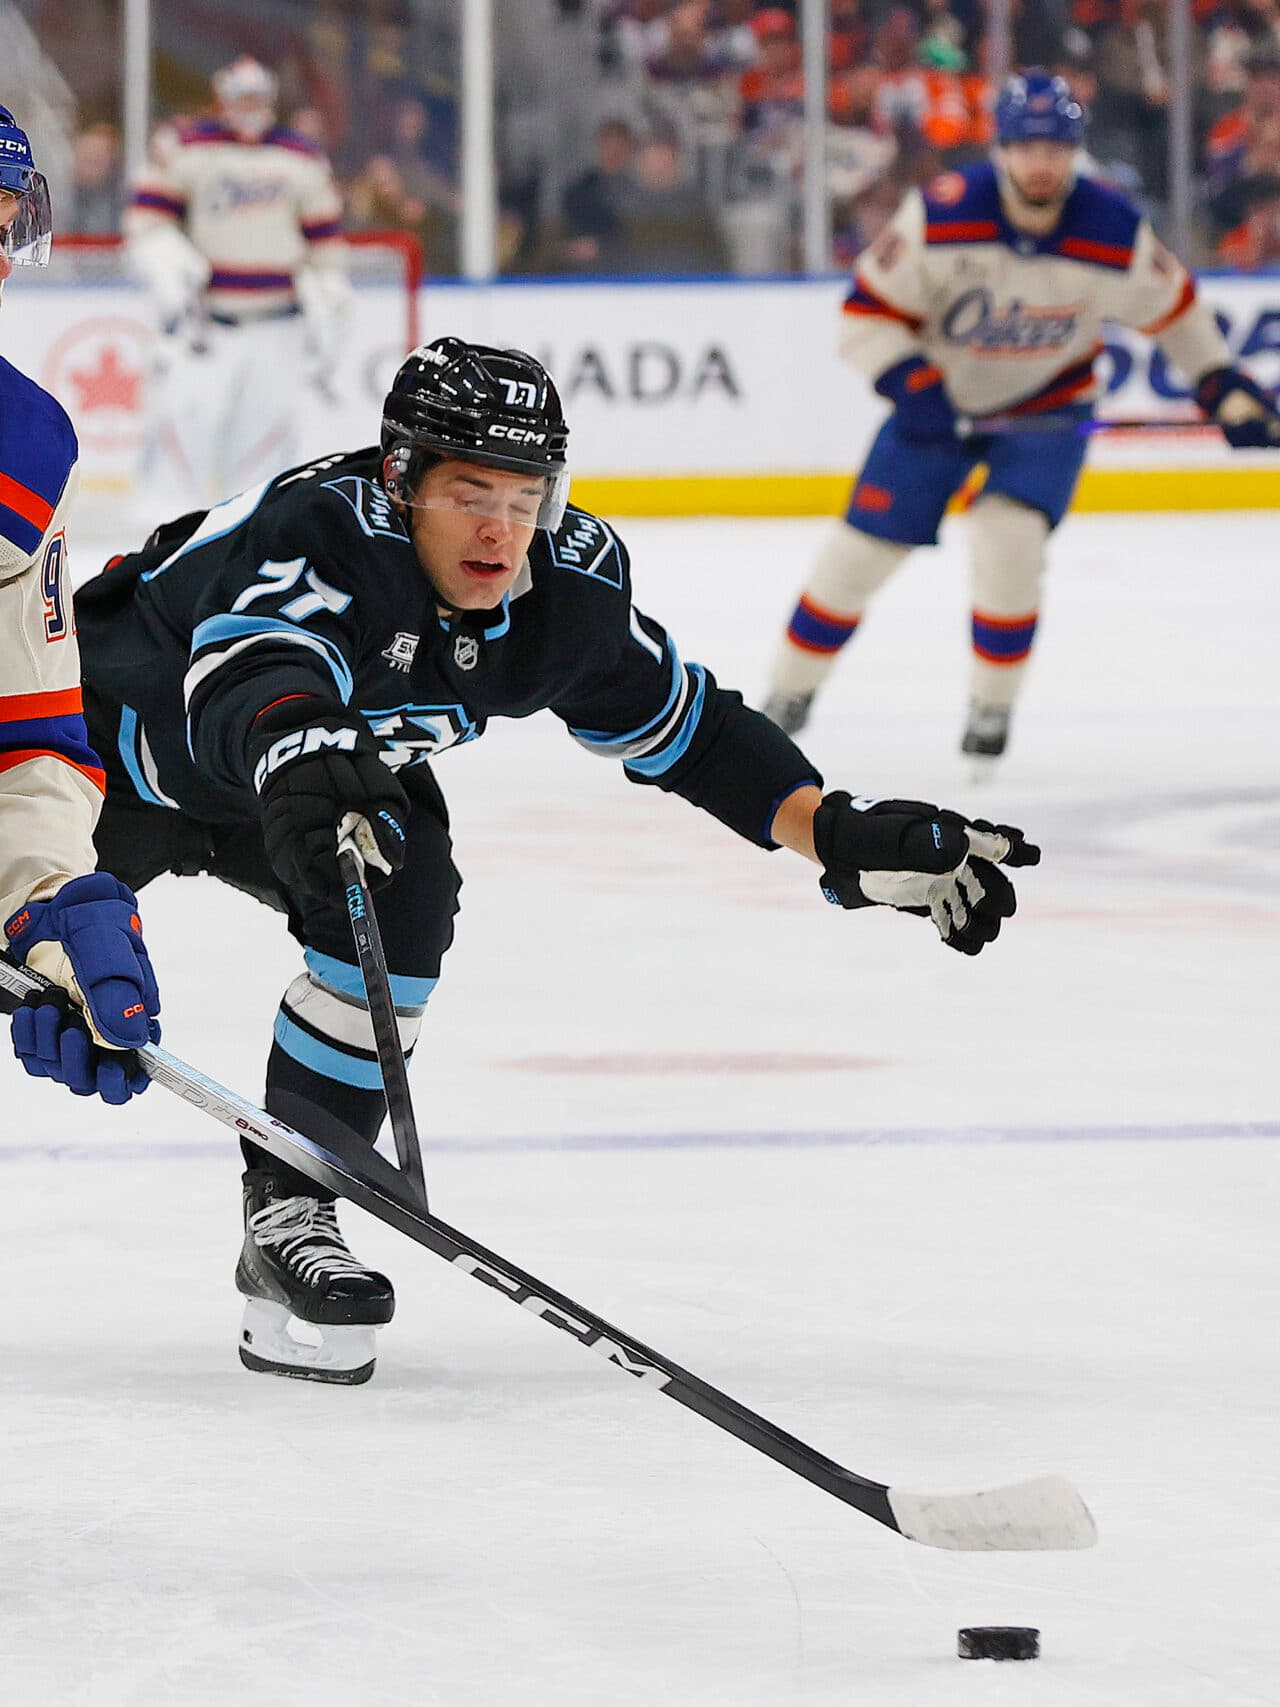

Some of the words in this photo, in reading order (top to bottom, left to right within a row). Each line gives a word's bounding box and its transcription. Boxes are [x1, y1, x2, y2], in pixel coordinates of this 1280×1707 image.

[497, 378, 537, 409] 77
[488, 424, 546, 446] CCM
[560, 517, 598, 563] UTAH
[230, 556, 353, 622] 77
[5, 910, 32, 936] CCM
